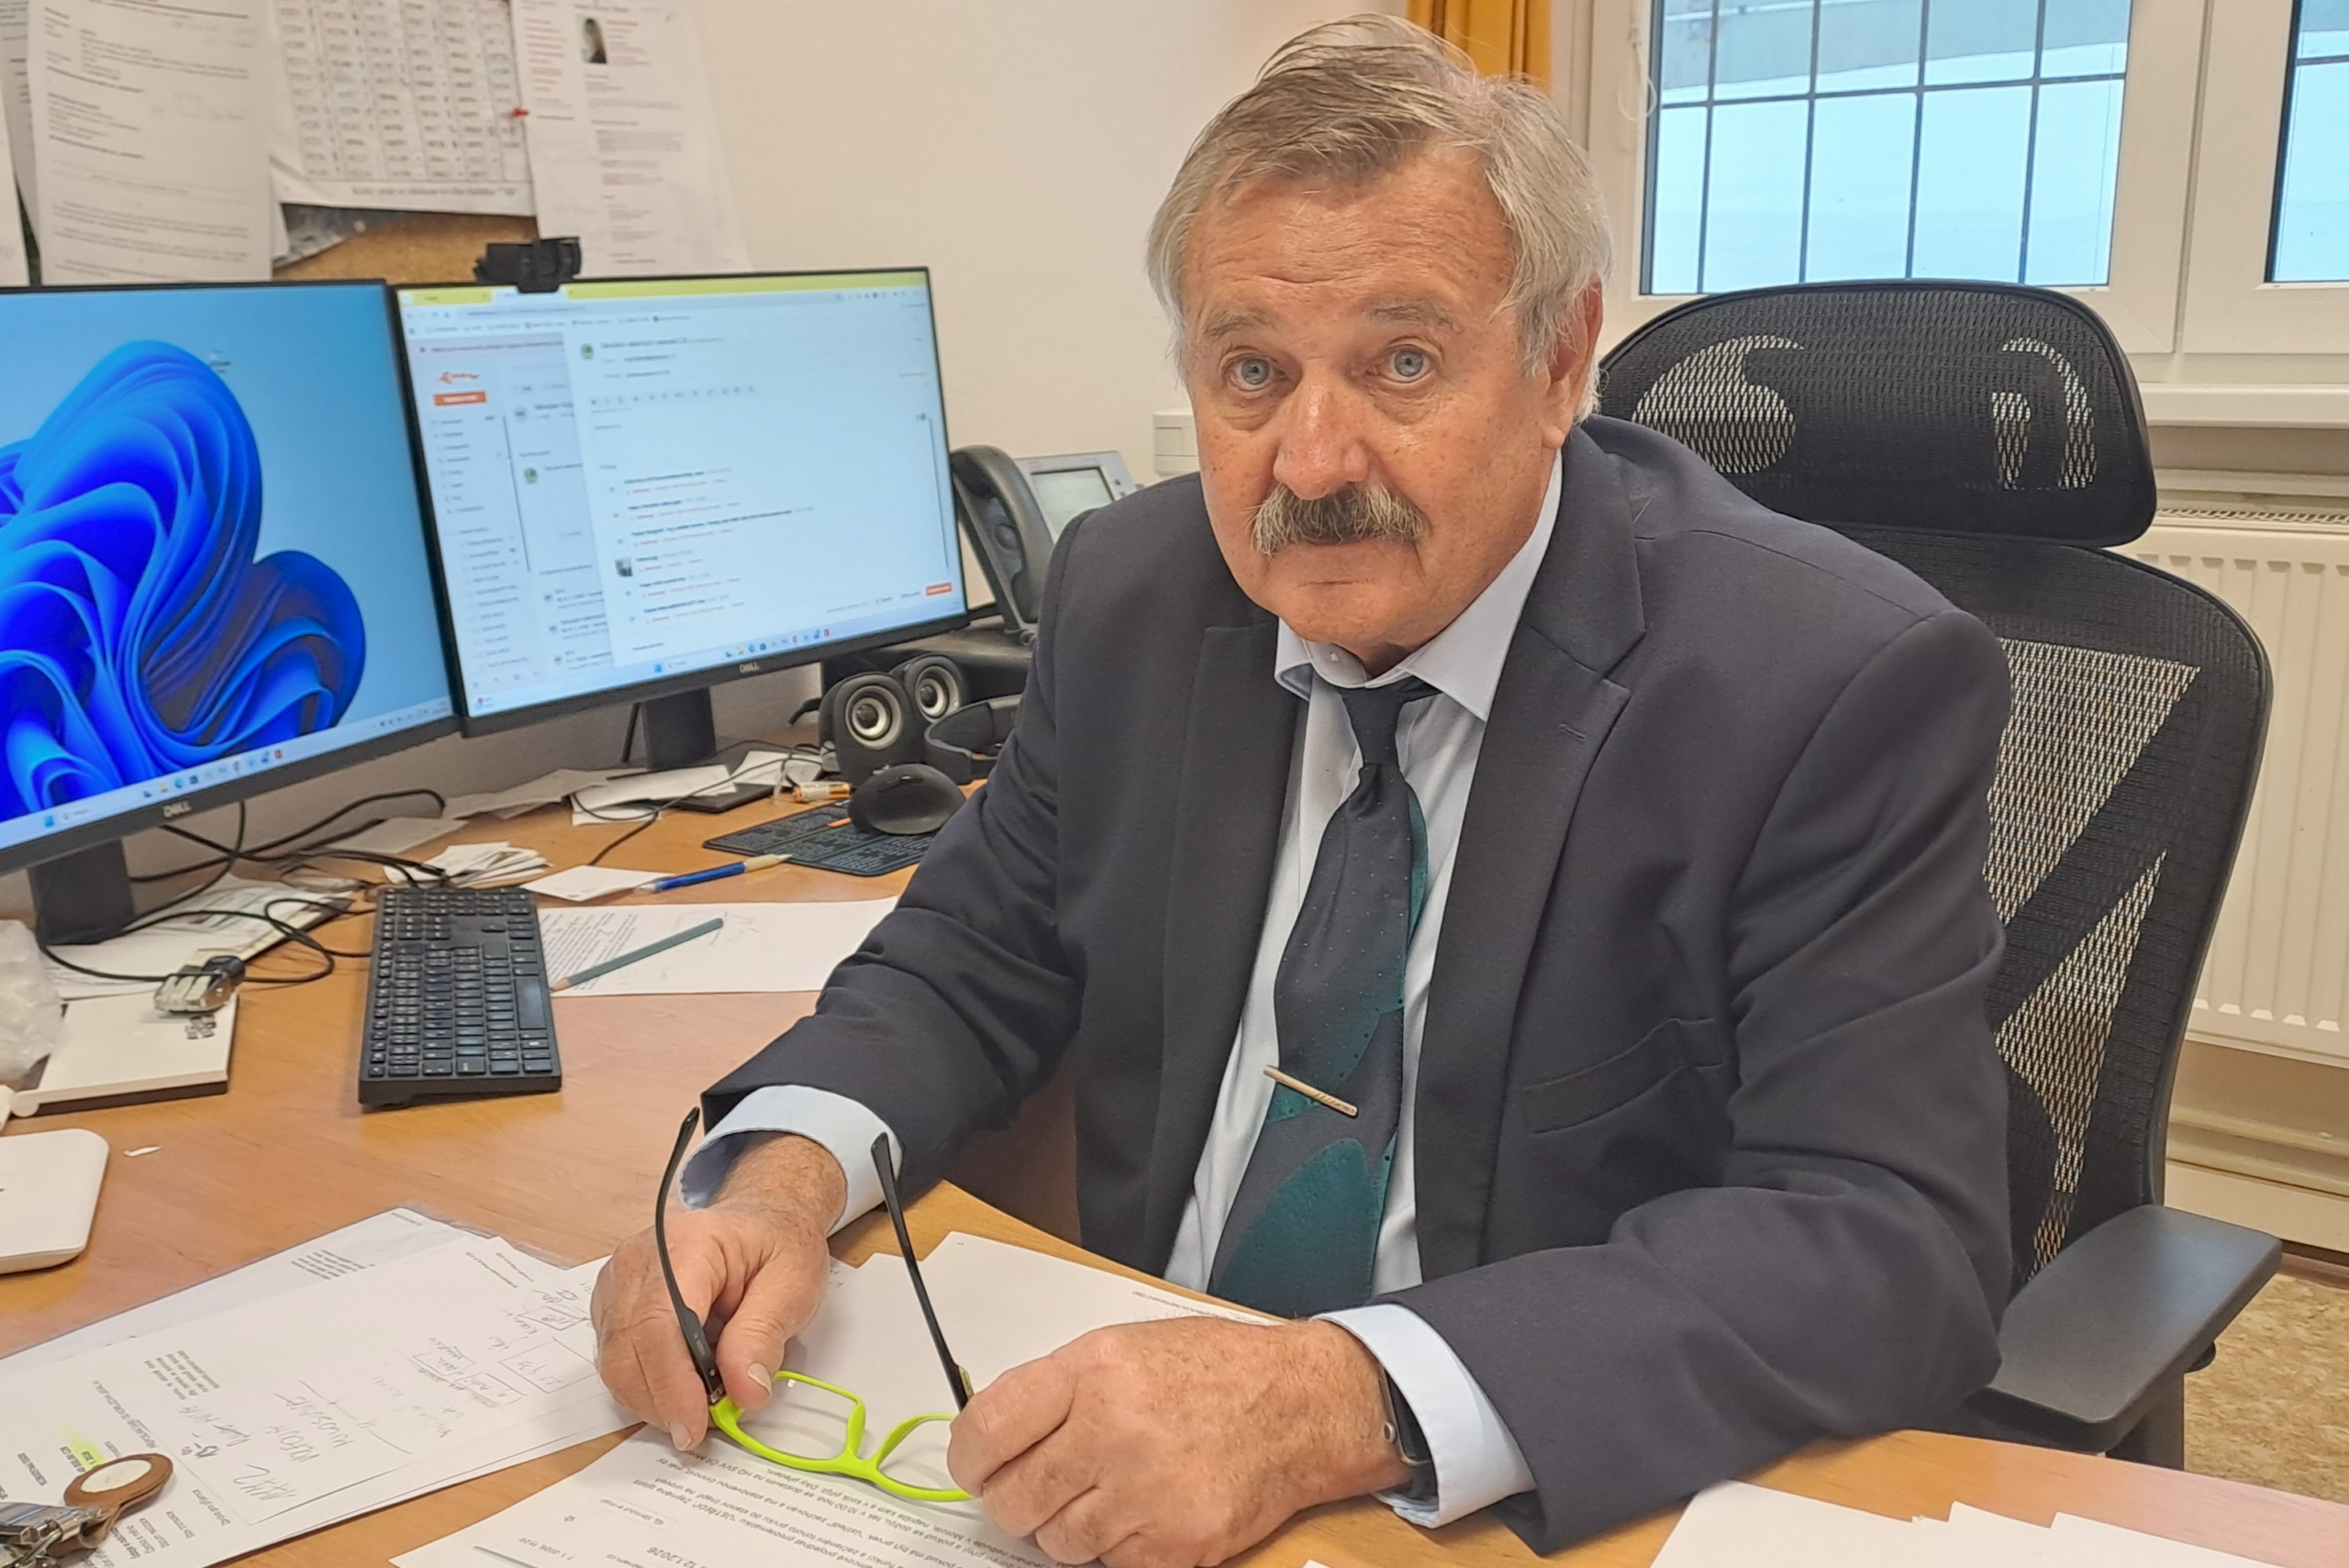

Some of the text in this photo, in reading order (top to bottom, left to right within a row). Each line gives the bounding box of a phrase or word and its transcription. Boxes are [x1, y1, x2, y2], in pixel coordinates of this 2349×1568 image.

[740, 662, 760, 673] DELL
[163, 801, 191, 817] DELL
[632, 1479, 657, 1489] zjistit
[716, 1481, 765, 1499] stanovenou
[764, 1478, 804, 1493] dostavím
[798, 1481, 819, 1490] Díky
[655, 1488, 693, 1504] Zejména
[816, 1496, 836, 1506] hod.
[841, 1496, 863, 1505] kolik
[719, 1502, 750, 1514] stanov
[785, 1506, 829, 1523] zachován
[833, 1503, 859, 1514] 10.00
[876, 1507, 897, 1517] kam
[762, 1517, 790, 1528] prvku
[896, 1514, 930, 1528] napište
[739, 1518, 796, 1541] problematiku
[787, 1527, 818, 1540] tohoto
[816, 1538, 860, 1554] začlenění
[867, 1535, 895, 1546] prvek
[923, 1534, 956, 1547] pokud
[793, 1540, 839, 1557] projednat
[892, 1543, 909, 1552] být
[973, 1540, 1009, 1556] nebude
[606, 1554, 645, 1568] znam.cz
[646, 1547, 698, 1568] 12.1.2026
[923, 1555, 957, 1568] pokud
